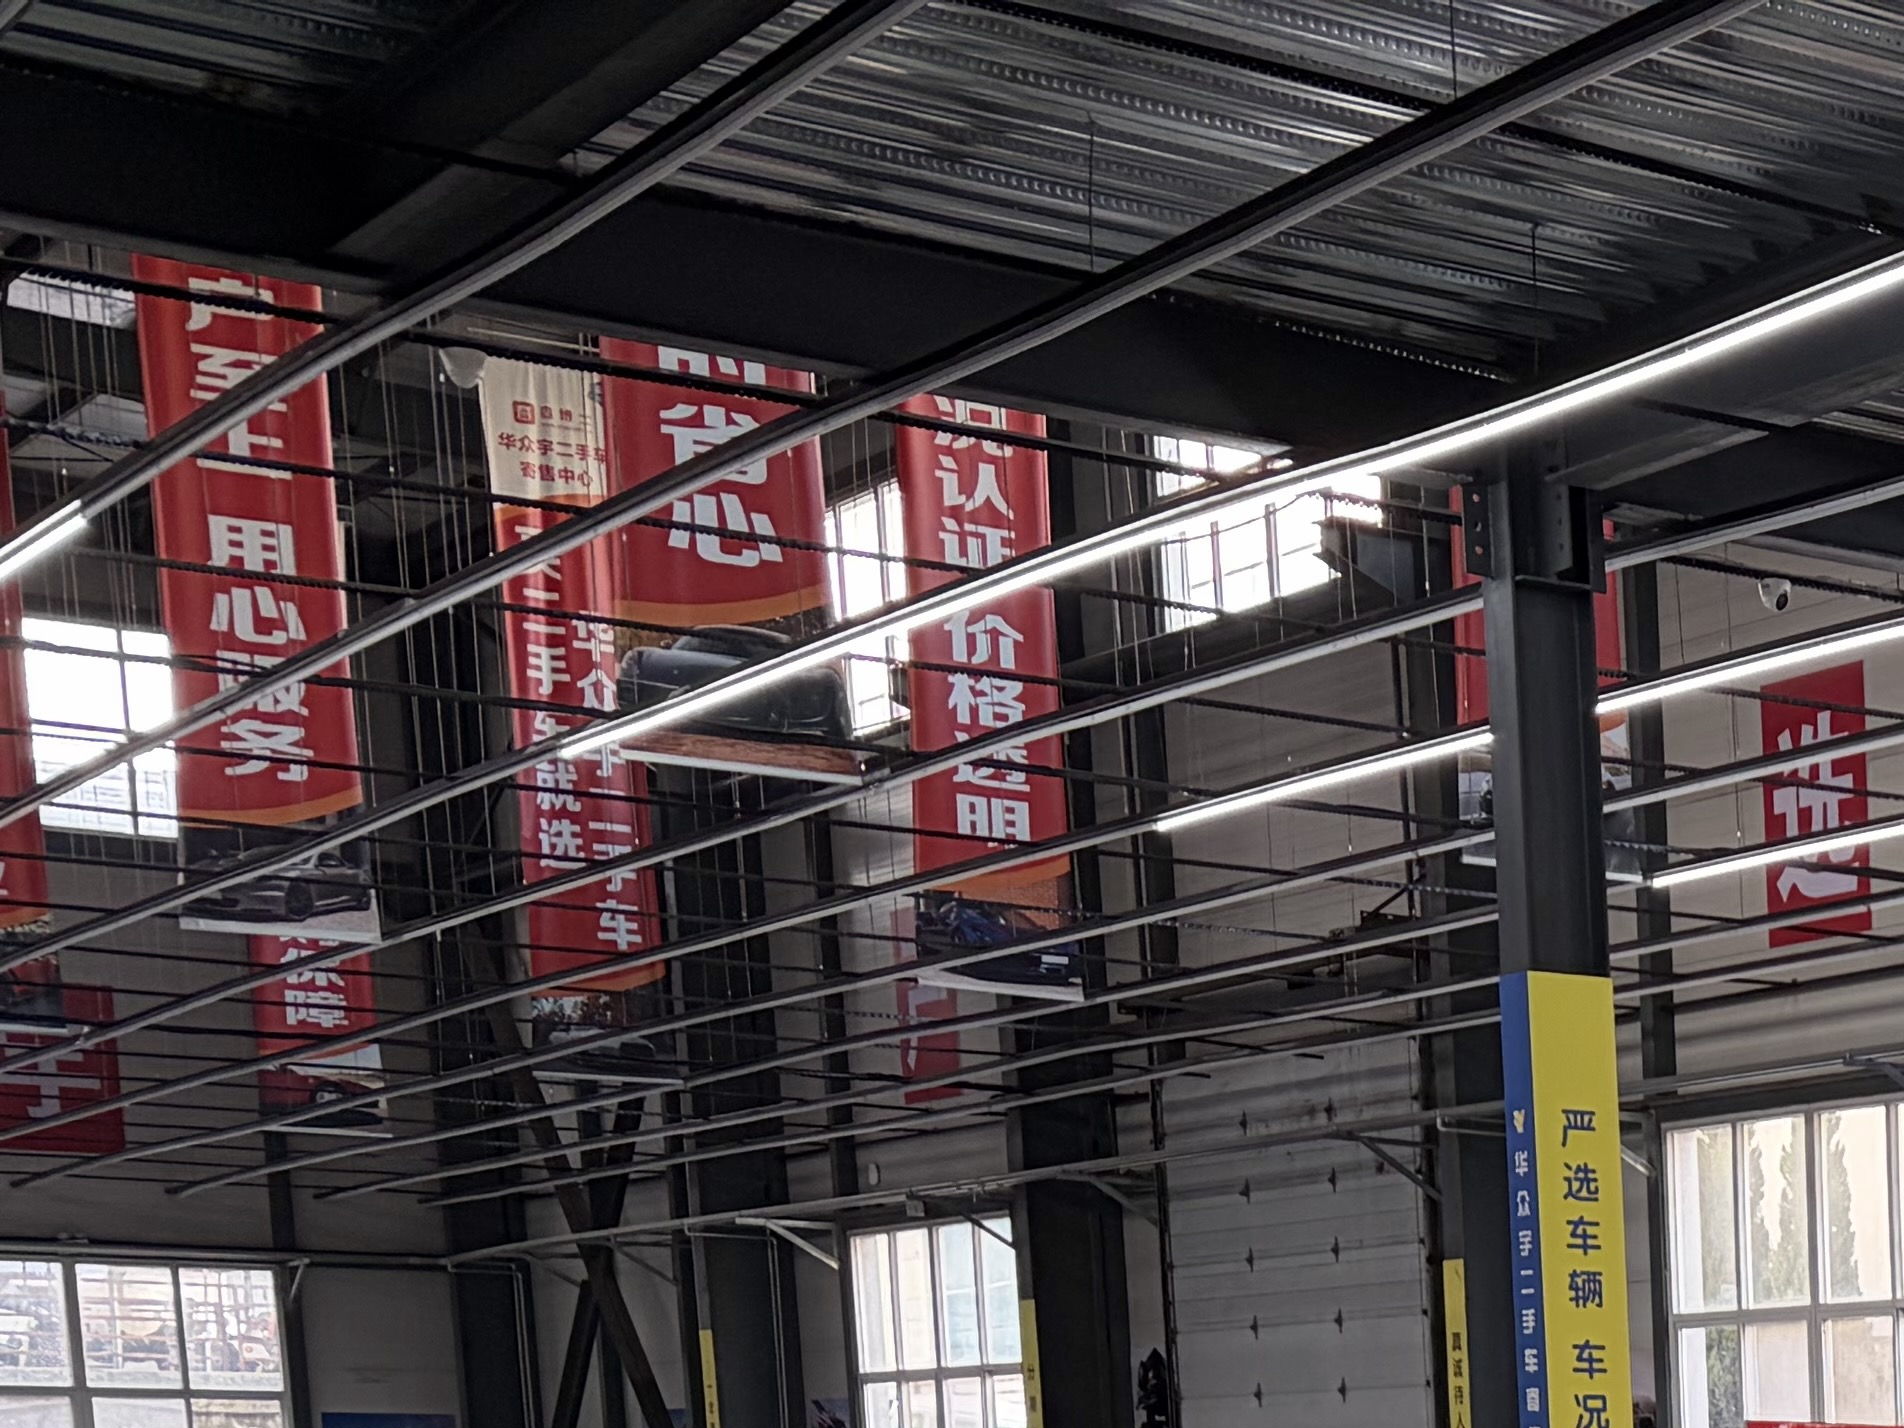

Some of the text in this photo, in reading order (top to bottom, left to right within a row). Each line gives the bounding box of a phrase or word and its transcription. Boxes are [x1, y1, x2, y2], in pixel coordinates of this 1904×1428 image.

[1763, 709, 1860, 904] 选
[1561, 1108, 1603, 1309] 严选车辆
